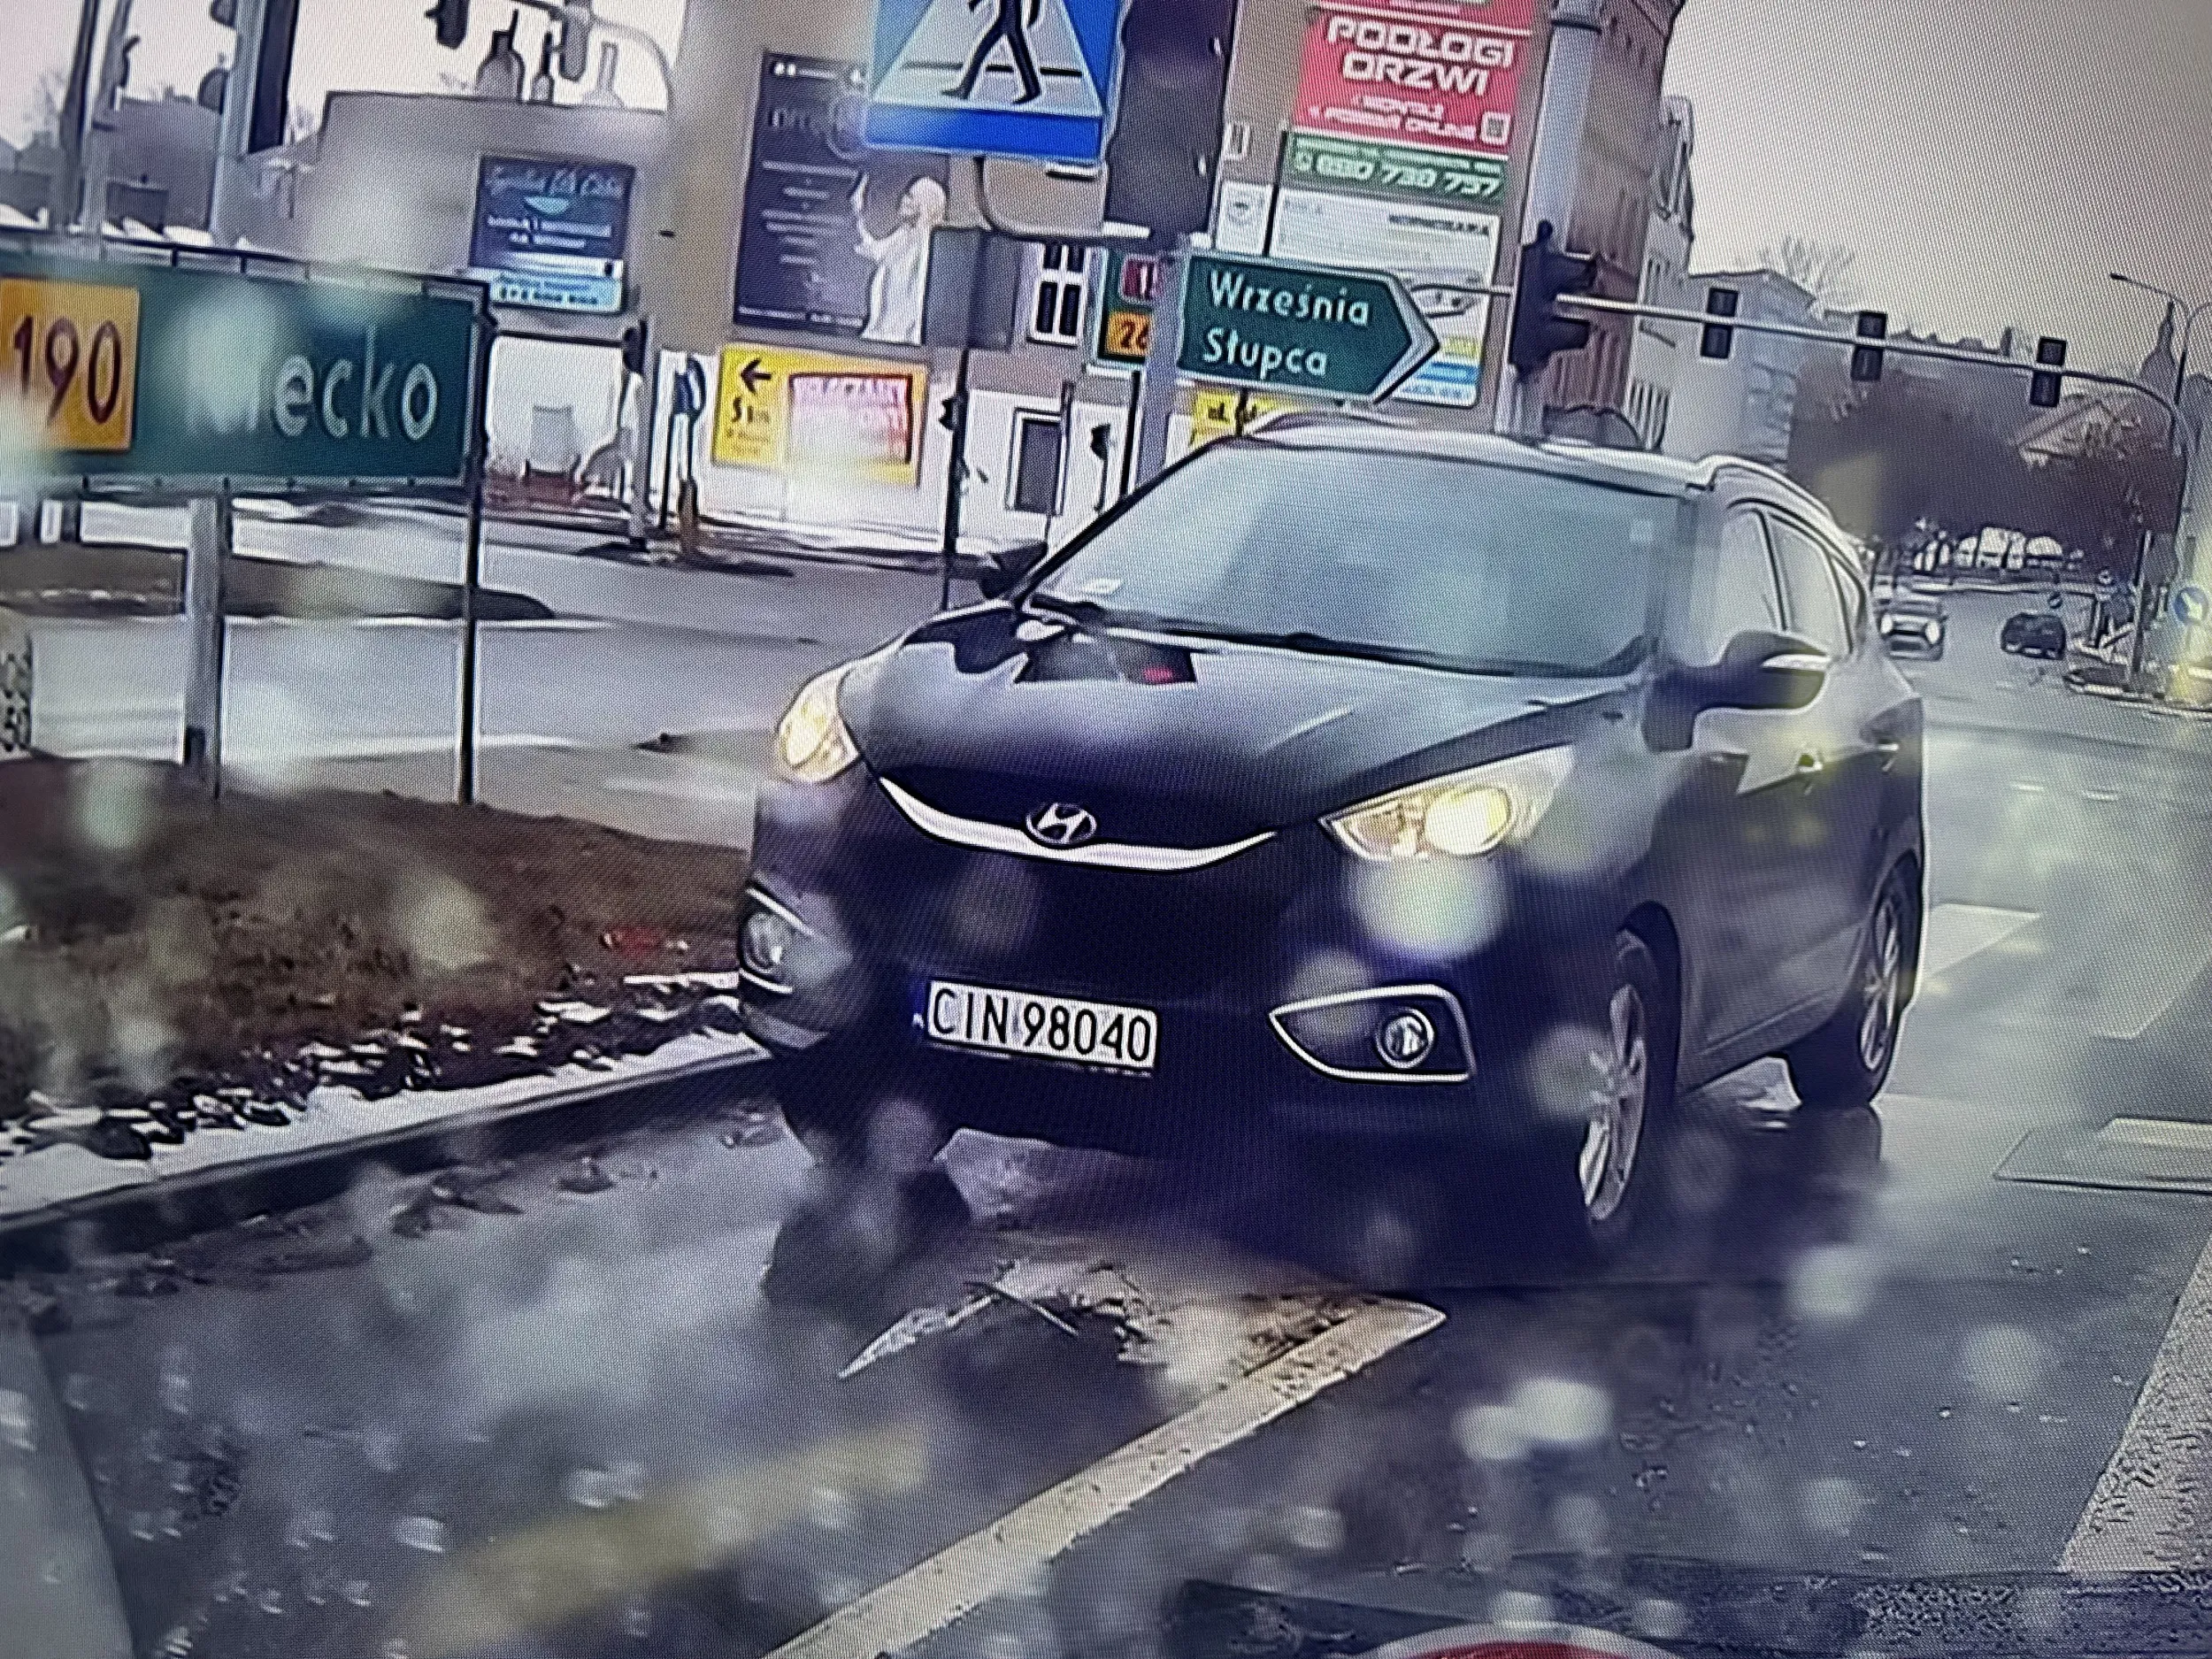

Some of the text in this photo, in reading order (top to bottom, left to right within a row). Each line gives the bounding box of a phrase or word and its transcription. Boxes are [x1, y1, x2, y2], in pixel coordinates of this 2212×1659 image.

[1327, 16, 1513, 68] PODŁOGI
[1210, 269, 1370, 327] Września
[13, 314, 122, 426] 190
[1202, 326, 1327, 380] Słupca
[933, 987, 1151, 1062] CIN 98040
